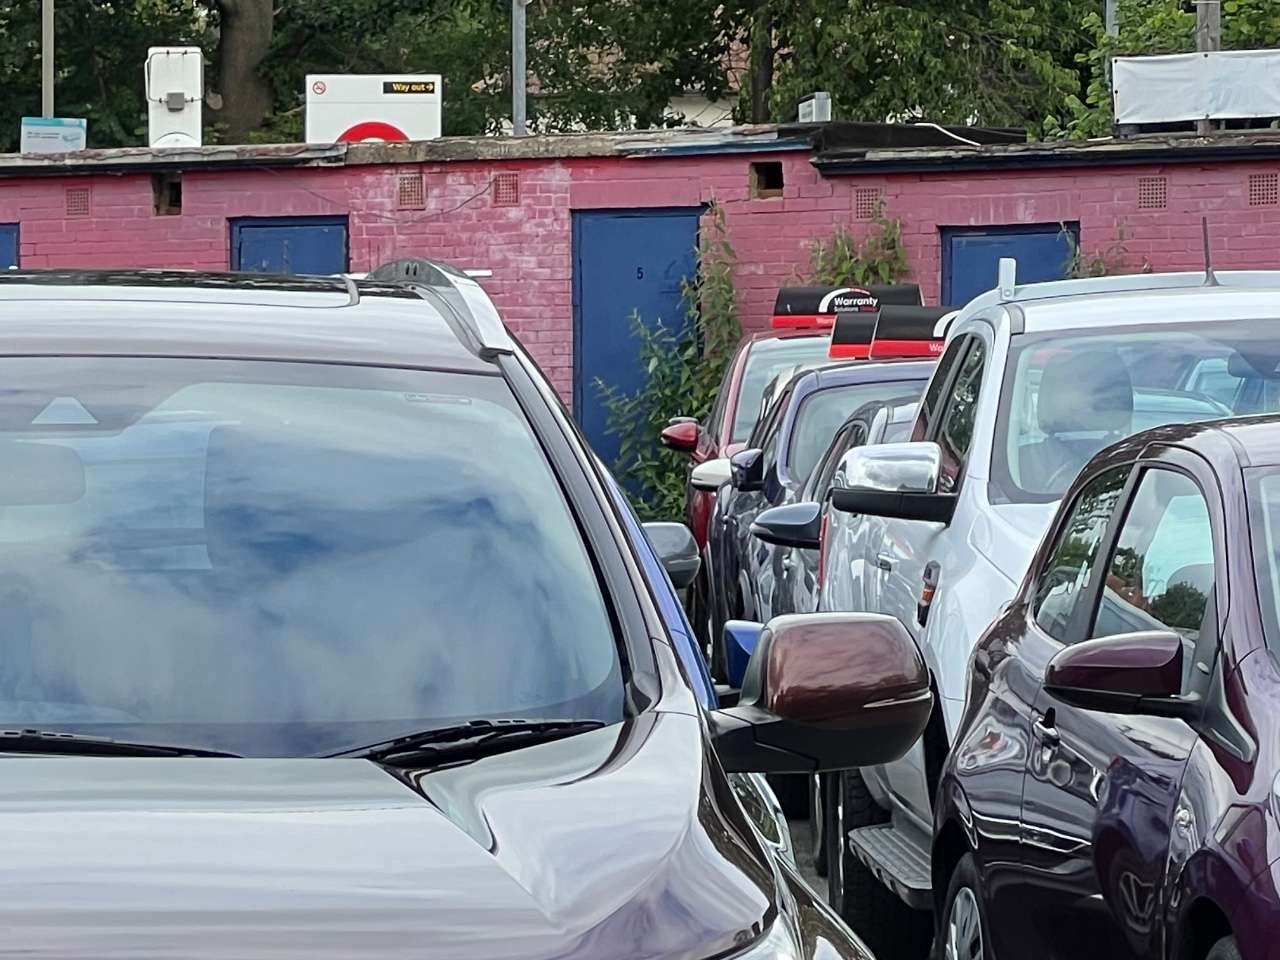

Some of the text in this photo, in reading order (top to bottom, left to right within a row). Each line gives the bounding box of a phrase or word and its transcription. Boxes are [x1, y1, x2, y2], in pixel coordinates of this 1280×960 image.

[392, 83, 410, 92] Way
[636, 266, 644, 280] 5
[834, 296, 879, 307] Warranty
